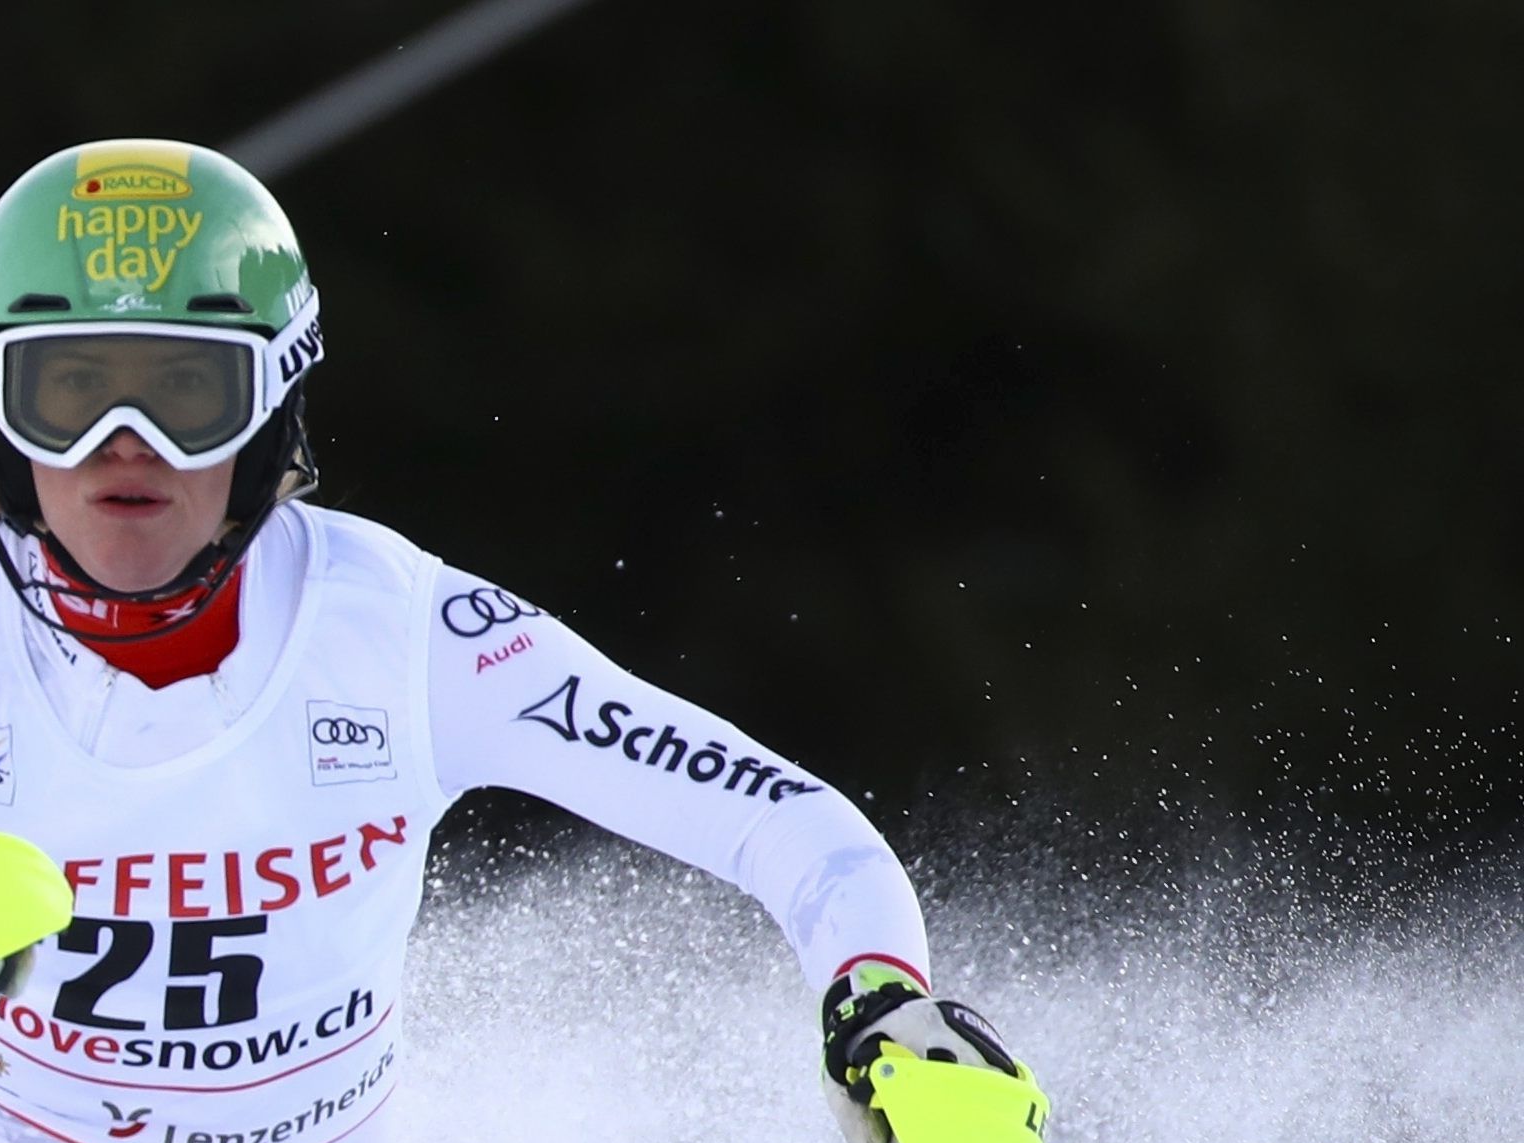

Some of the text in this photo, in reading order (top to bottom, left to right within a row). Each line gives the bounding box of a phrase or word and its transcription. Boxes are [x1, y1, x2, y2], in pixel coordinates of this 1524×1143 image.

[103, 175, 176, 192] RAUCH
[58, 204, 203, 250] happy
[86, 236, 177, 293] day
[279, 320, 323, 383] uve
[475, 633, 533, 674] Audi
[52, 914, 269, 1032] 25
